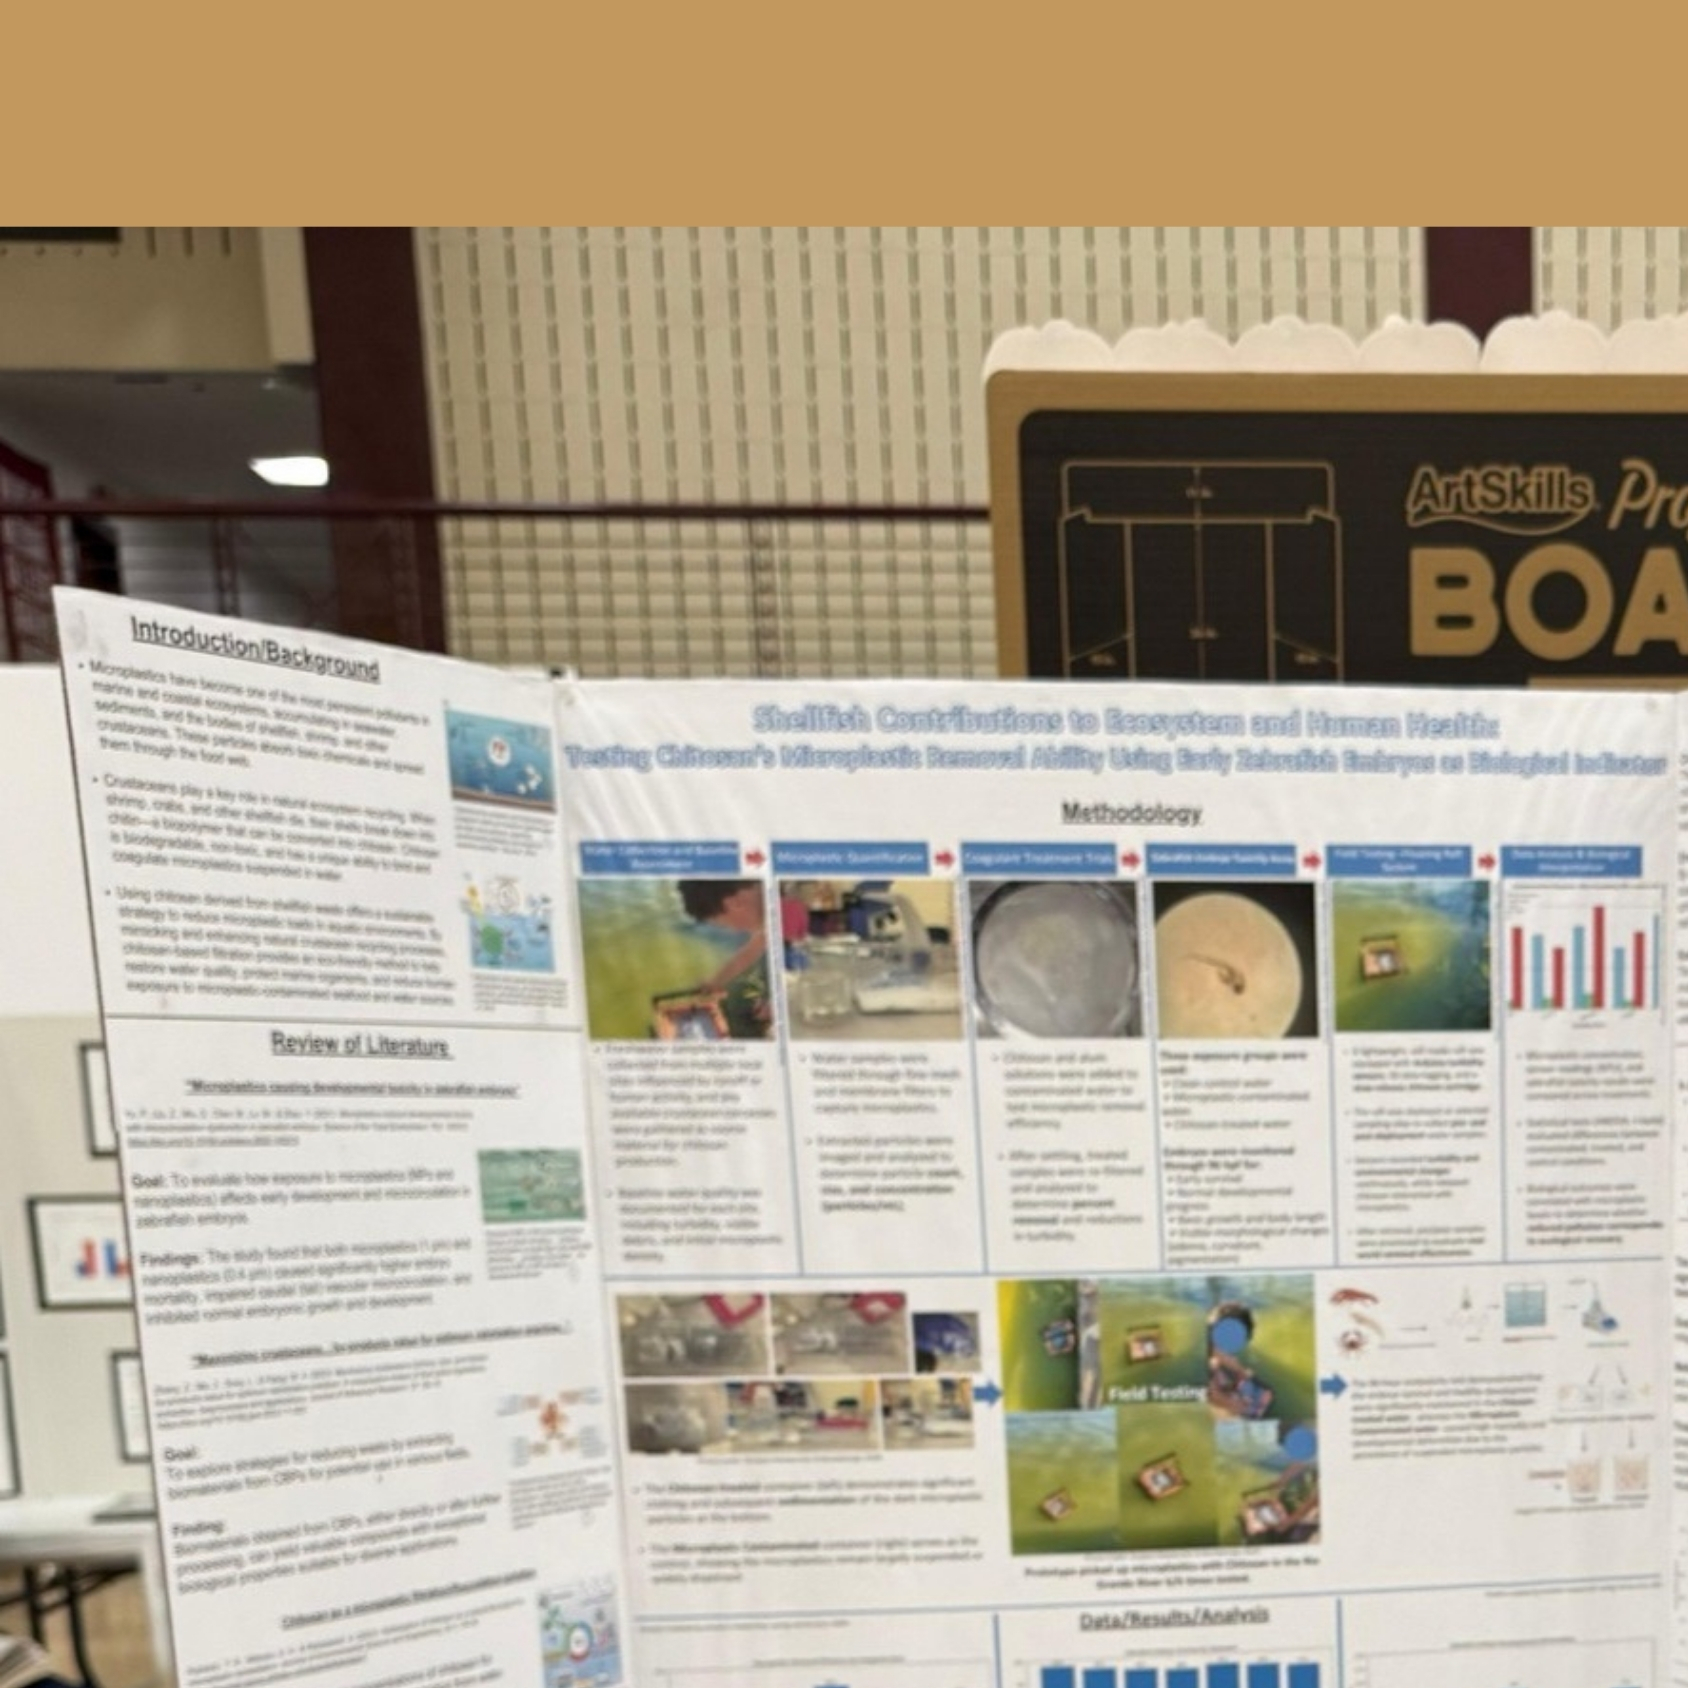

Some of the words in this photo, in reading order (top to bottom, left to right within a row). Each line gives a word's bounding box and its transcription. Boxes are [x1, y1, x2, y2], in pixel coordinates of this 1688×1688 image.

[1408, 466, 1596, 518] ArtSkills
[131, 615, 381, 684] Introduction/Background
[876, 704, 1063, 736] Contributions
[1068, 709, 1099, 735] to
[1104, 709, 1246, 742] Ecosystem
[1250, 709, 1300, 738] and
[1307, 711, 1401, 739] Human
[563, 743, 651, 773] Testing
[780, 745, 923, 773] Microplastic
[927, 744, 1026, 771] Removal
[1030, 745, 1103, 774] Ability
[1109, 746, 1171, 776] Using
[1175, 748, 1232, 777] Early
[1061, 801, 1202, 826] Methodology
[271, 1031, 340, 1056] Review
[344, 1033, 362, 1056] of
[366, 1034, 451, 1060] Literature
[1079, 1606, 1270, 1632] Data/Results/Analysis
